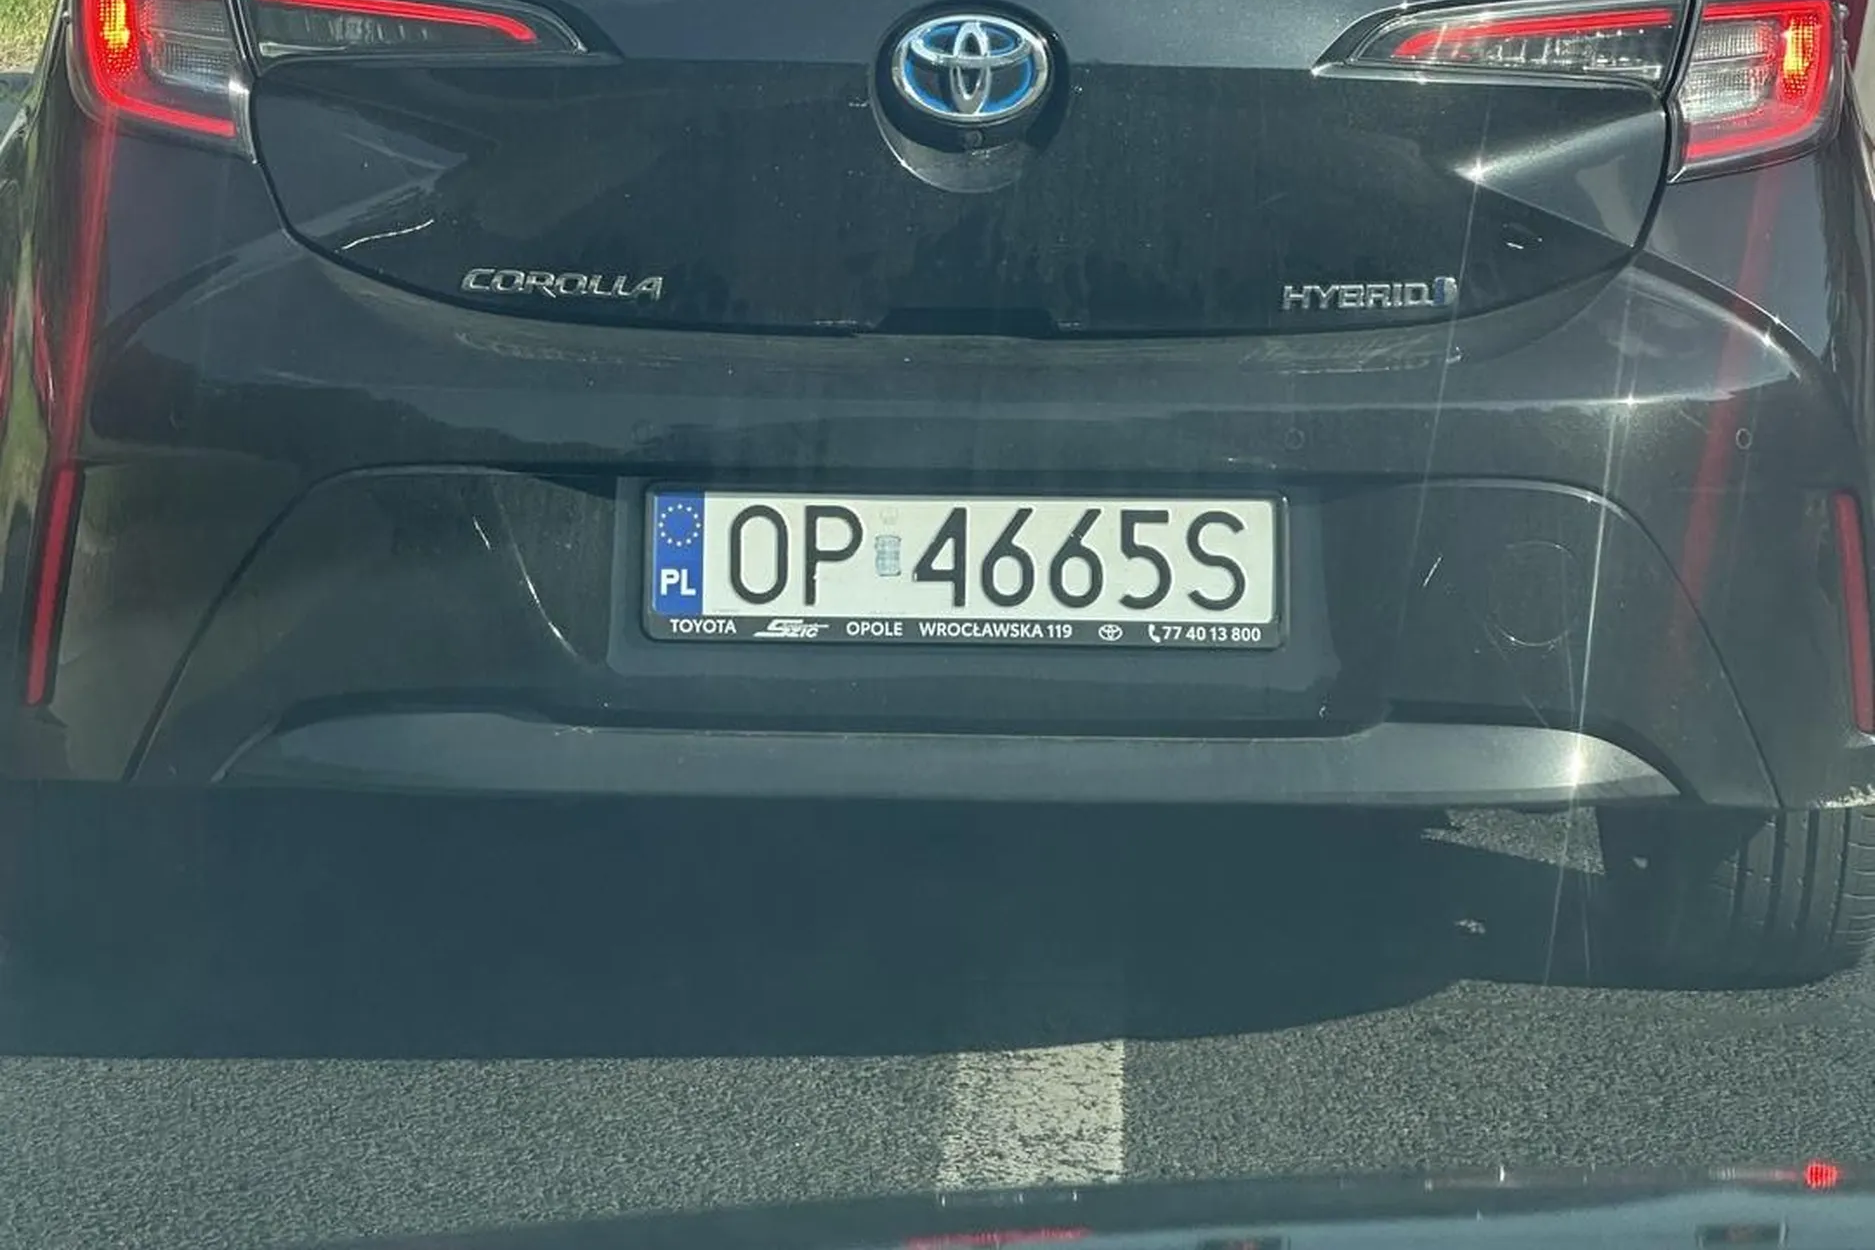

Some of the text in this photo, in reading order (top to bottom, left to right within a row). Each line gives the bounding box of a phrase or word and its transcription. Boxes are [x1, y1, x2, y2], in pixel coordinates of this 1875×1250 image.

[461, 268, 664, 300] COROLLA
[1283, 283, 1434, 310] HYBRID
[730, 504, 1246, 612] OP 4665S
[660, 568, 697, 596] PL
[669, 619, 737, 634] TOYOTA
[846, 622, 903, 637] OPOLE
[919, 622, 1043, 638] WROCŁAWSKA
[1047, 624, 1073, 638] 119
[1162, 626, 1182, 640] 77
[1185, 626, 1206, 641] 40
[1209, 626, 1228, 641] 13
[1231, 627, 1261, 642] 800
